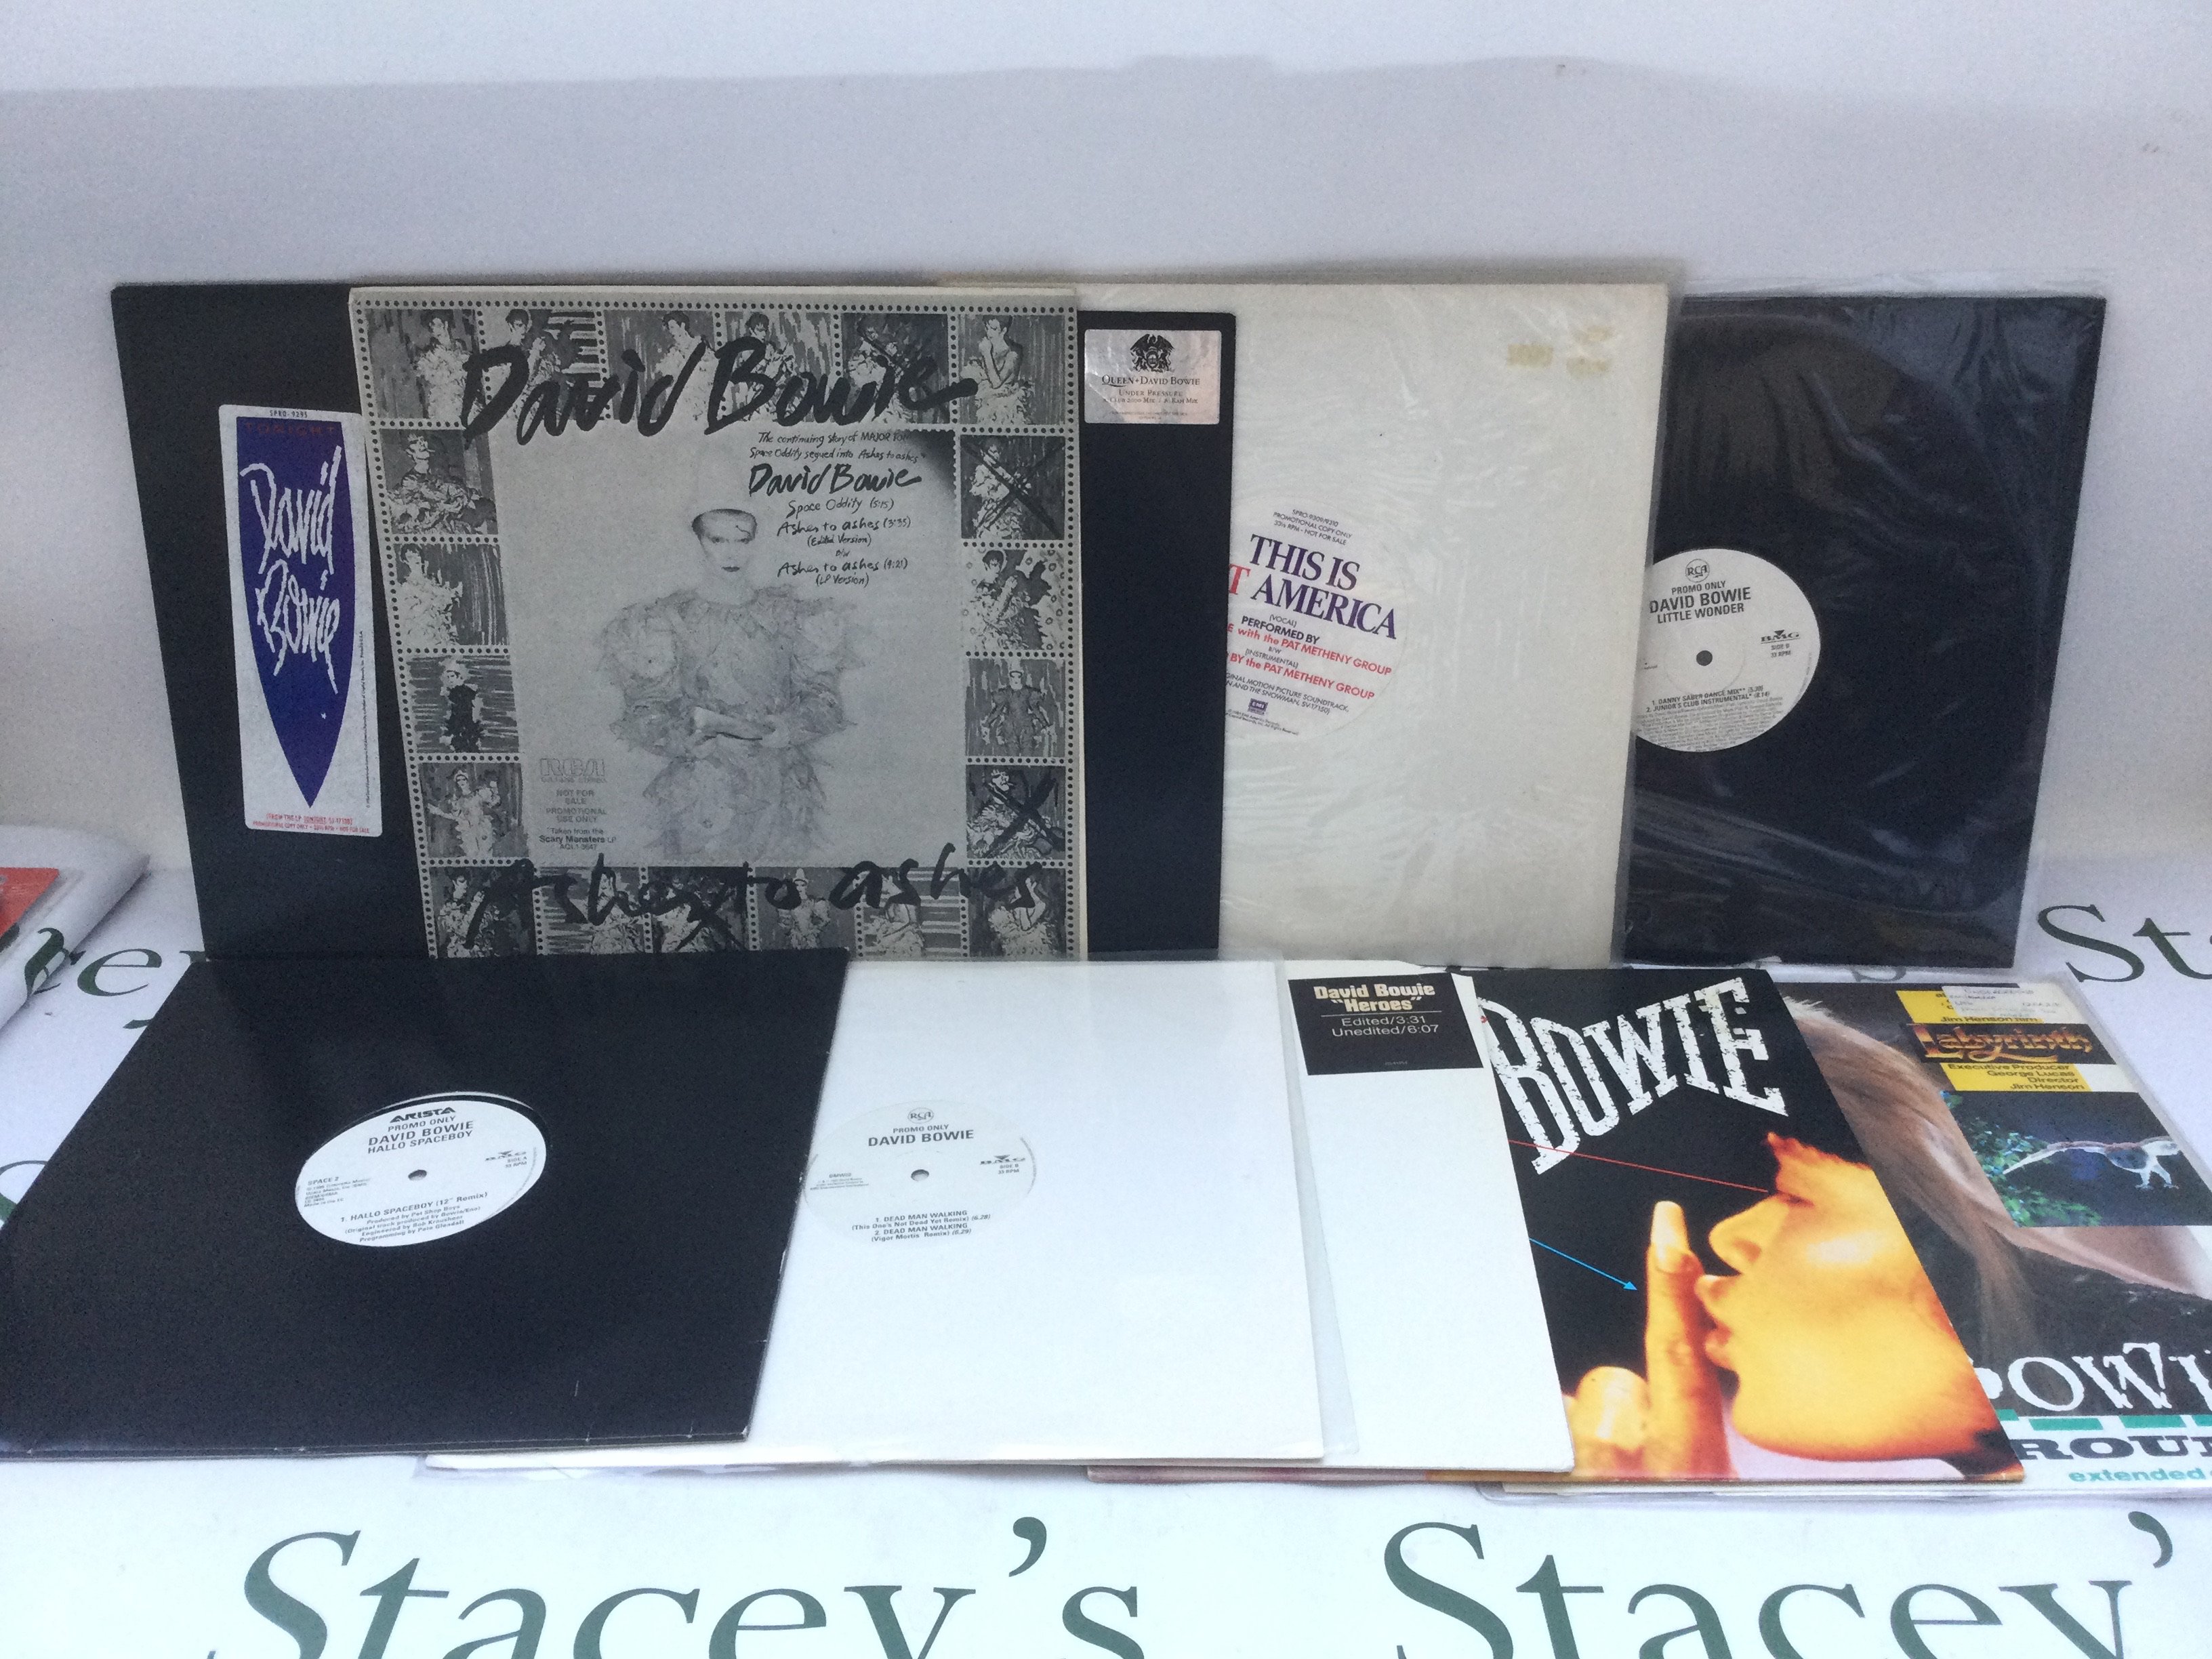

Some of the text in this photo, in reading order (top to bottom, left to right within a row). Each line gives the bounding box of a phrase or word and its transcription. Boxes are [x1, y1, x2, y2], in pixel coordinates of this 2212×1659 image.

[1170, 377, 1200, 386] BOWIE
[461, 337, 979, 445] David Bowie
[758, 432, 773, 443] The
[777, 433, 825, 448] continuing
[827, 432, 848, 446] story
[847, 430, 858, 443] of
[861, 431, 890, 441] MAJOR
[750, 447, 895, 462] Space Oddity segued into Ashes to
[748, 463, 922, 497] David Bowie
[785, 497, 862, 518] Space Oddity
[777, 520, 819, 536] Ashes
[823, 521, 837, 531] to
[842, 517, 880, 531] ashes
[1273, 512, 1317, 529] PROMOTIONAL
[1318, 525, 1334, 535] COPY
[1305, 529, 1318, 537] NOT
[1332, 537, 1347, 546] SALE
[777, 558, 880, 577] Ashes to ashes
[1250, 533, 1360, 591] THIS IS
[1687, 565, 1708, 577] RCA
[1671, 581, 1725, 595] PROMO ONLY
[1229, 563, 1397, 640] T AMERICA
[1650, 587, 1751, 613] DAVID BOWIE
[1658, 603, 1744, 623] LITTLE WONDER
[1242, 615, 1320, 644] PERFORMED BY
[1238, 628, 1392, 676] with the PAT METHENY GROUP
[1230, 653, 1375, 699] BY the PAT METHENY GROUP
[1233, 682, 1248, 690] AND
[1247, 678, 1301, 698] MOTION PICTURE
[1683, 700, 1699, 708] CLUB
[539, 758, 605, 777] RCA
[539, 835, 563, 844] Scary
[566, 835, 605, 843] Monsters
[730, 862, 799, 910] to
[829, 842, 1044, 912] ashes
[1313, 983, 1435, 1000] David Bowie
[1331, 996, 1422, 1012] "Heroes"
[1341, 1015, 1426, 1027] Edited/3:31
[1332, 1024, 1439, 1037] Unedited/6:07
[1906, 1023, 2093, 1063] Labyrinth
[1476, 977, 1789, 1175] BOWIE
[388, 1115, 456, 1132] PROMO ONLY
[390, 1107, 456, 1123] ARISTA
[910, 1111, 932, 1121] RCA
[369, 1120, 474, 1146] DAVID BOWIE
[868, 1130, 974, 1147] DAVID BOWIE
[893, 1126, 924, 1134] PROMO
[367, 1130, 473, 1154] HALLO SPACEBOY
[350, 1210, 381, 1221] HALLO
[384, 1202, 433, 1215] SPACEBOY
[930, 1210, 967, 1218] WALKING
[930, 1223, 967, 1231] WALKING
[2068, 1468, 2207, 1483] extended
